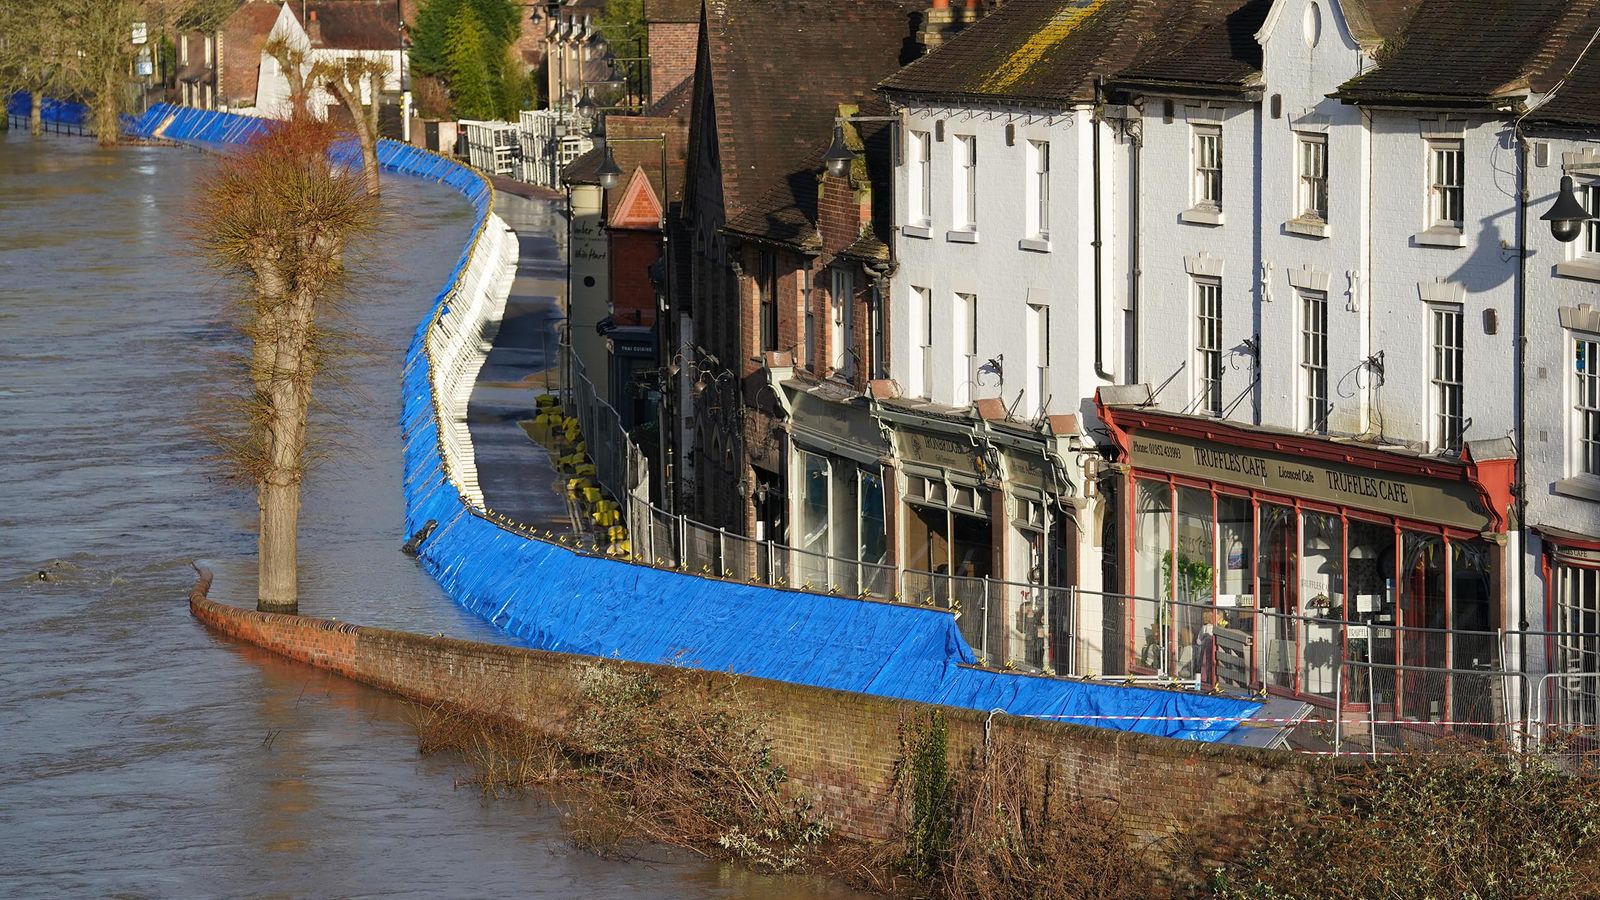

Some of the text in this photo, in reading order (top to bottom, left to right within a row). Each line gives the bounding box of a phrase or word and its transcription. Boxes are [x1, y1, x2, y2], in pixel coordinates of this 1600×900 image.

[1133, 441, 1148, 454] Phone:
[1149, 443, 1163, 457] 01952
[1194, 447, 1267, 477] TRUFFLES CAFE
[1302, 470, 1314, 483] Cafe
[1326, 471, 1409, 503] TRUFFLES CAFE
